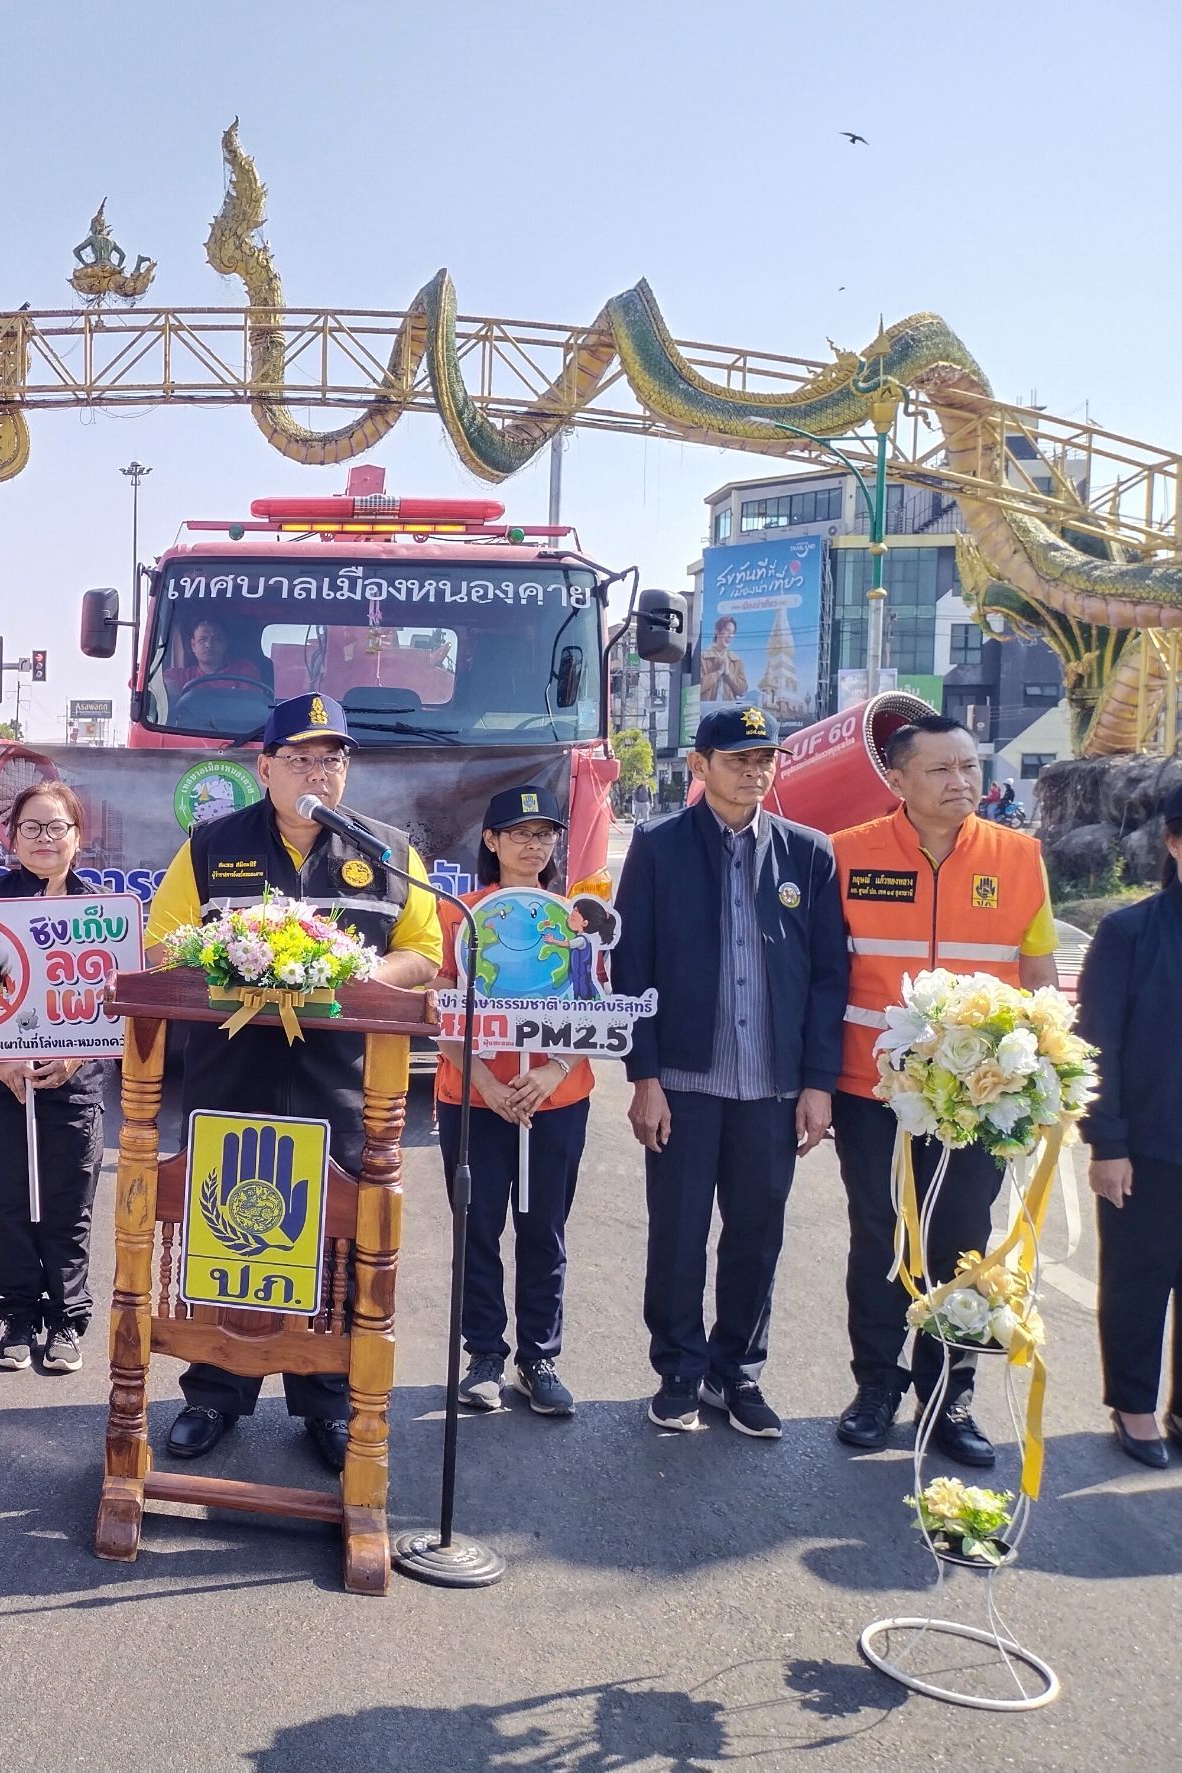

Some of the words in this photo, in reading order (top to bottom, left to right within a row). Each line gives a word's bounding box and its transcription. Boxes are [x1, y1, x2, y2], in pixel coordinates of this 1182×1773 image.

[167, 566, 591, 609] เทศบาลเมืองหนองคาย
[780, 731, 825, 769] LUF
[828, 716, 856, 744] 60
[46, 949, 116, 984] ลด
[438, 994, 457, 1009] ป่า
[562, 993, 654, 1016] อากาศบริสุทธิ์
[515, 1016, 629, 1052] PM2.5
[209, 1265, 302, 1305] ปภ.
